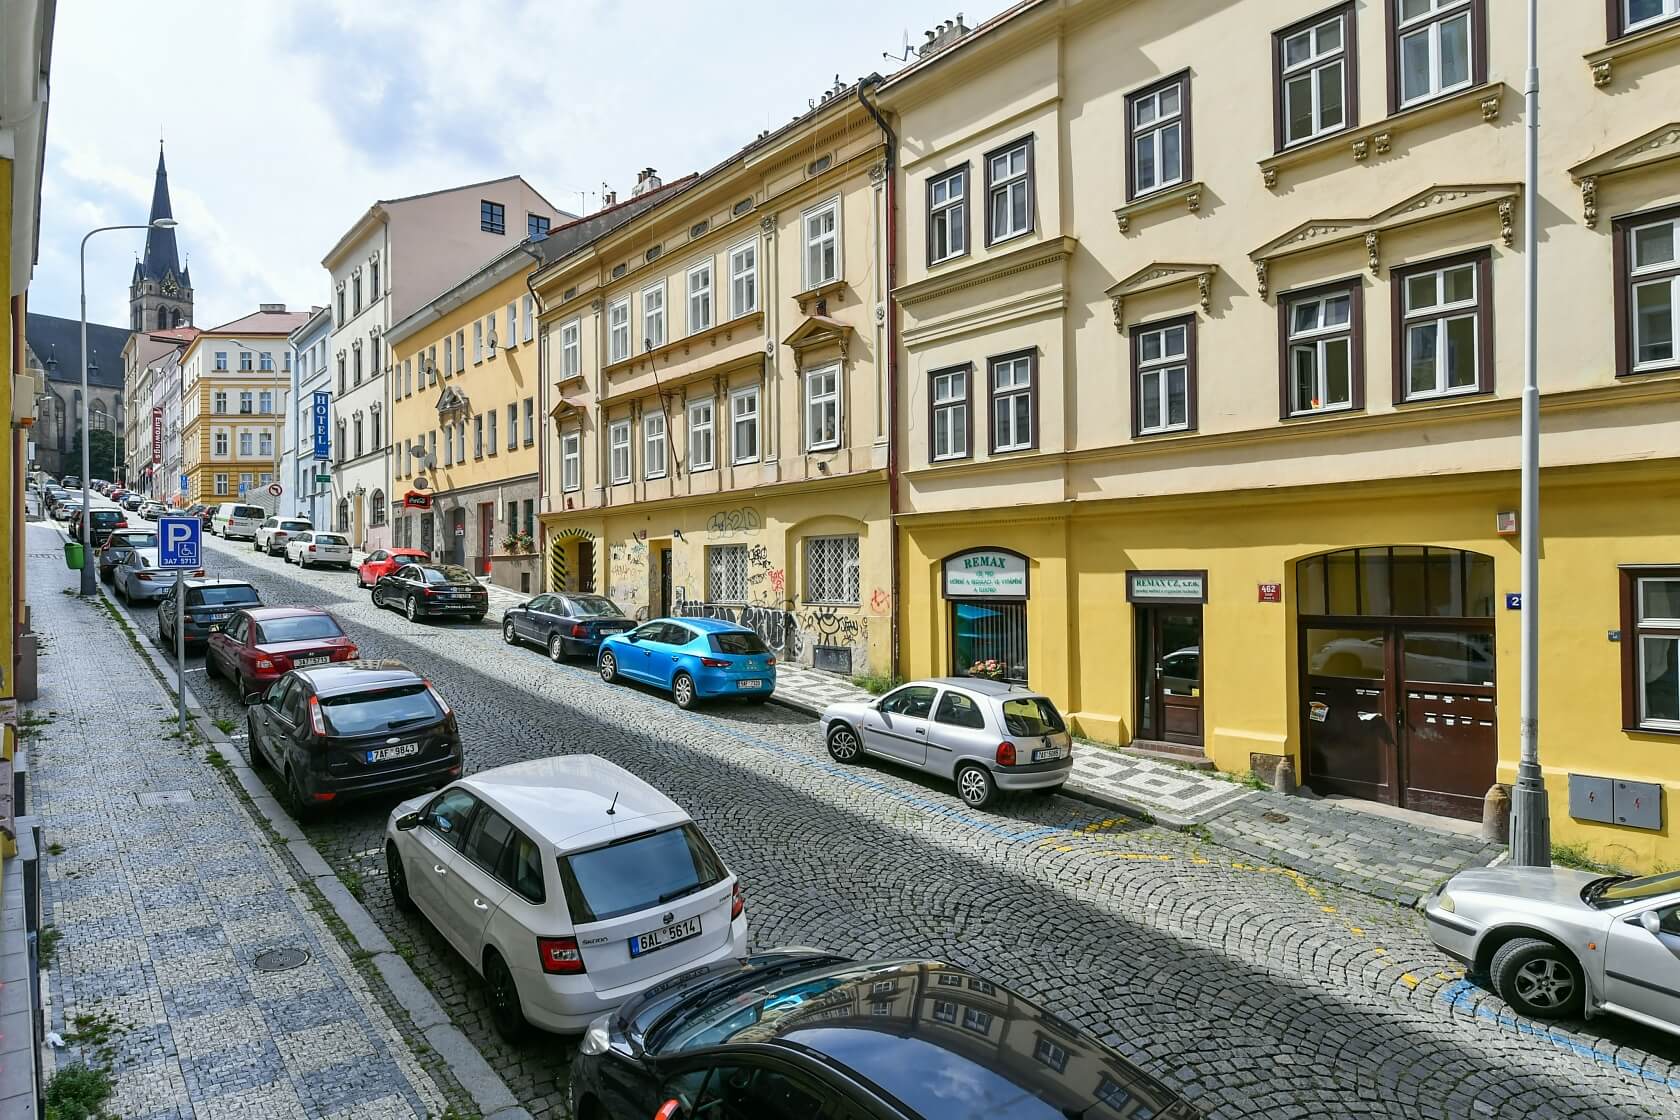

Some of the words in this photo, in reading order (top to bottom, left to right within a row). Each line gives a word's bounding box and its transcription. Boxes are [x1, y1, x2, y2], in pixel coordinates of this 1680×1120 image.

[316, 395, 327, 445] HOTEL
[168, 523, 192, 552] P
[963, 556, 1007, 569] REMAX
[1136, 579, 1165, 587] REMAX
[1511, 596, 1522, 606] 2
[373, 749, 389, 761] 7AF
[395, 744, 416, 756] 9843
[640, 934, 662, 950] 6AL
[669, 922, 697, 939] 5614
